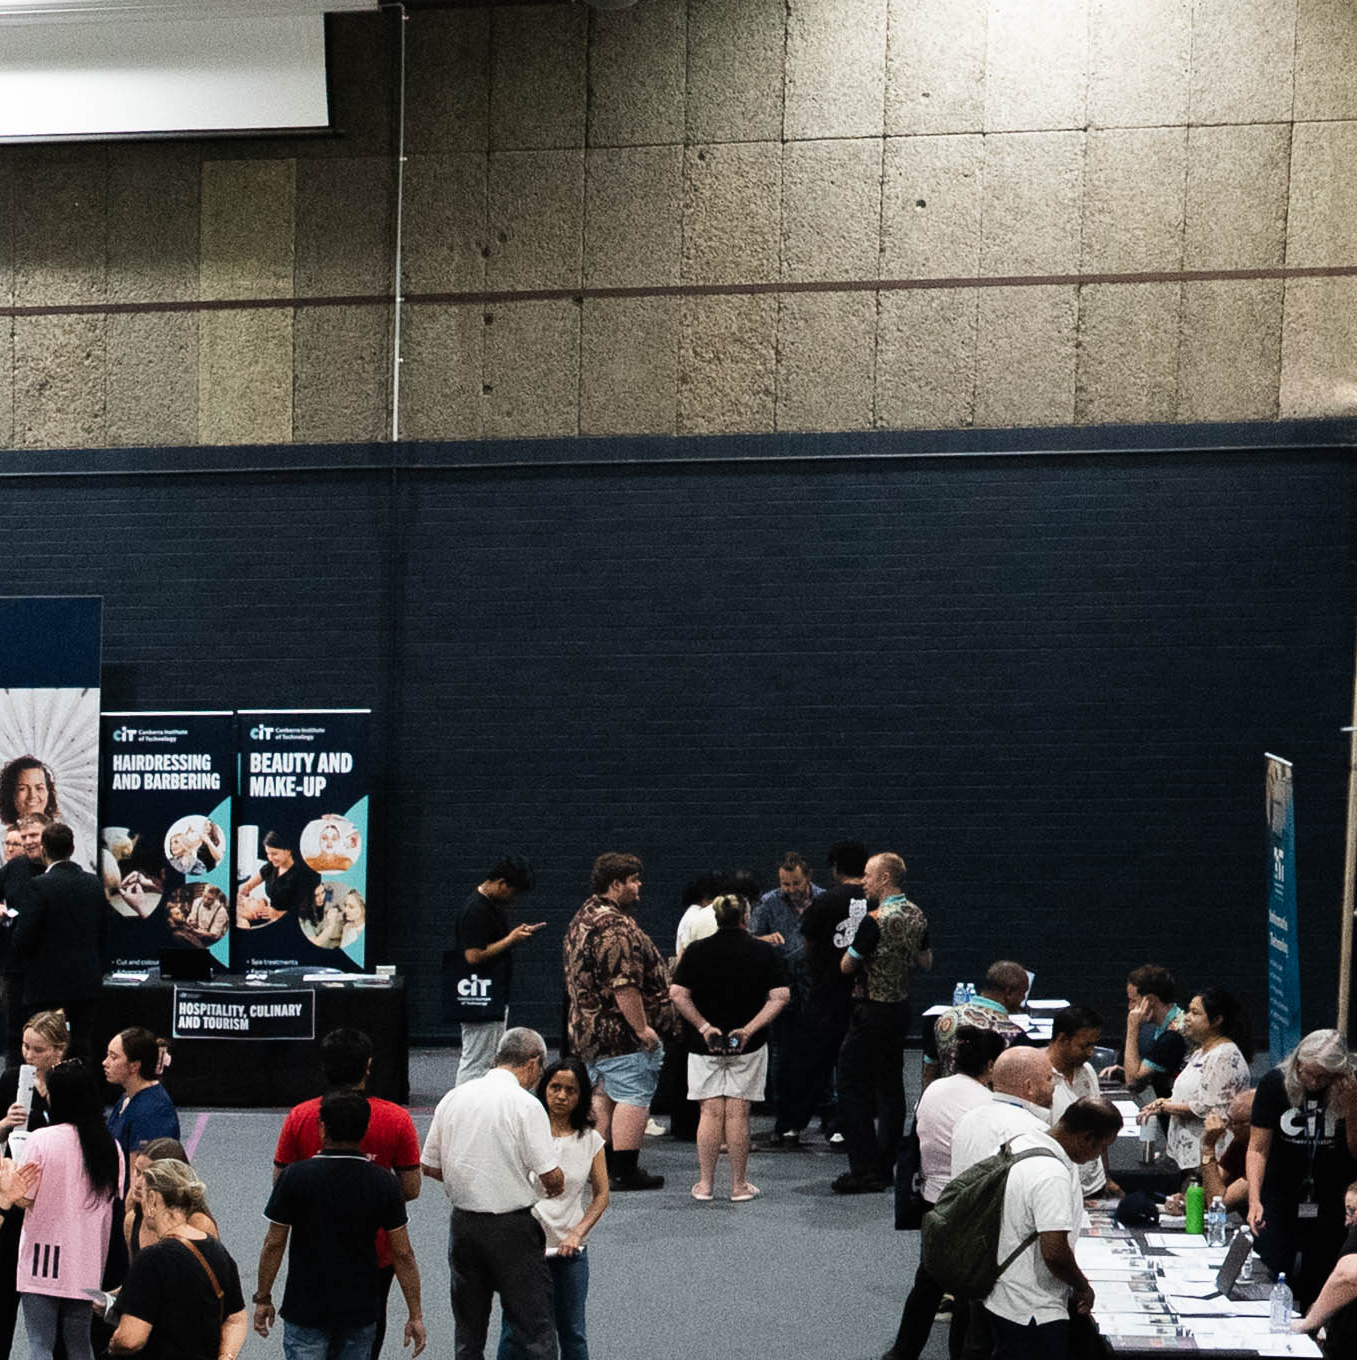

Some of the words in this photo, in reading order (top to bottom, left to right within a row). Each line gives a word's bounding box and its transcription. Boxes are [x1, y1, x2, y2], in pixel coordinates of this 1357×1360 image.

[113, 754, 211, 772] HAIRDRESSING
[250, 752, 315, 773] BEAUTY
[317, 752, 353, 774] AND
[112, 773, 141, 790] AND
[144, 772, 221, 790] BARBERING
[249, 776, 327, 798] MAKE-UP
[179, 1002, 247, 1018] HOSPITALITY,
[250, 1004, 302, 1017] CULINARY
[178, 1017, 200, 1029] AND
[203, 1017, 249, 1030] TOURISM
